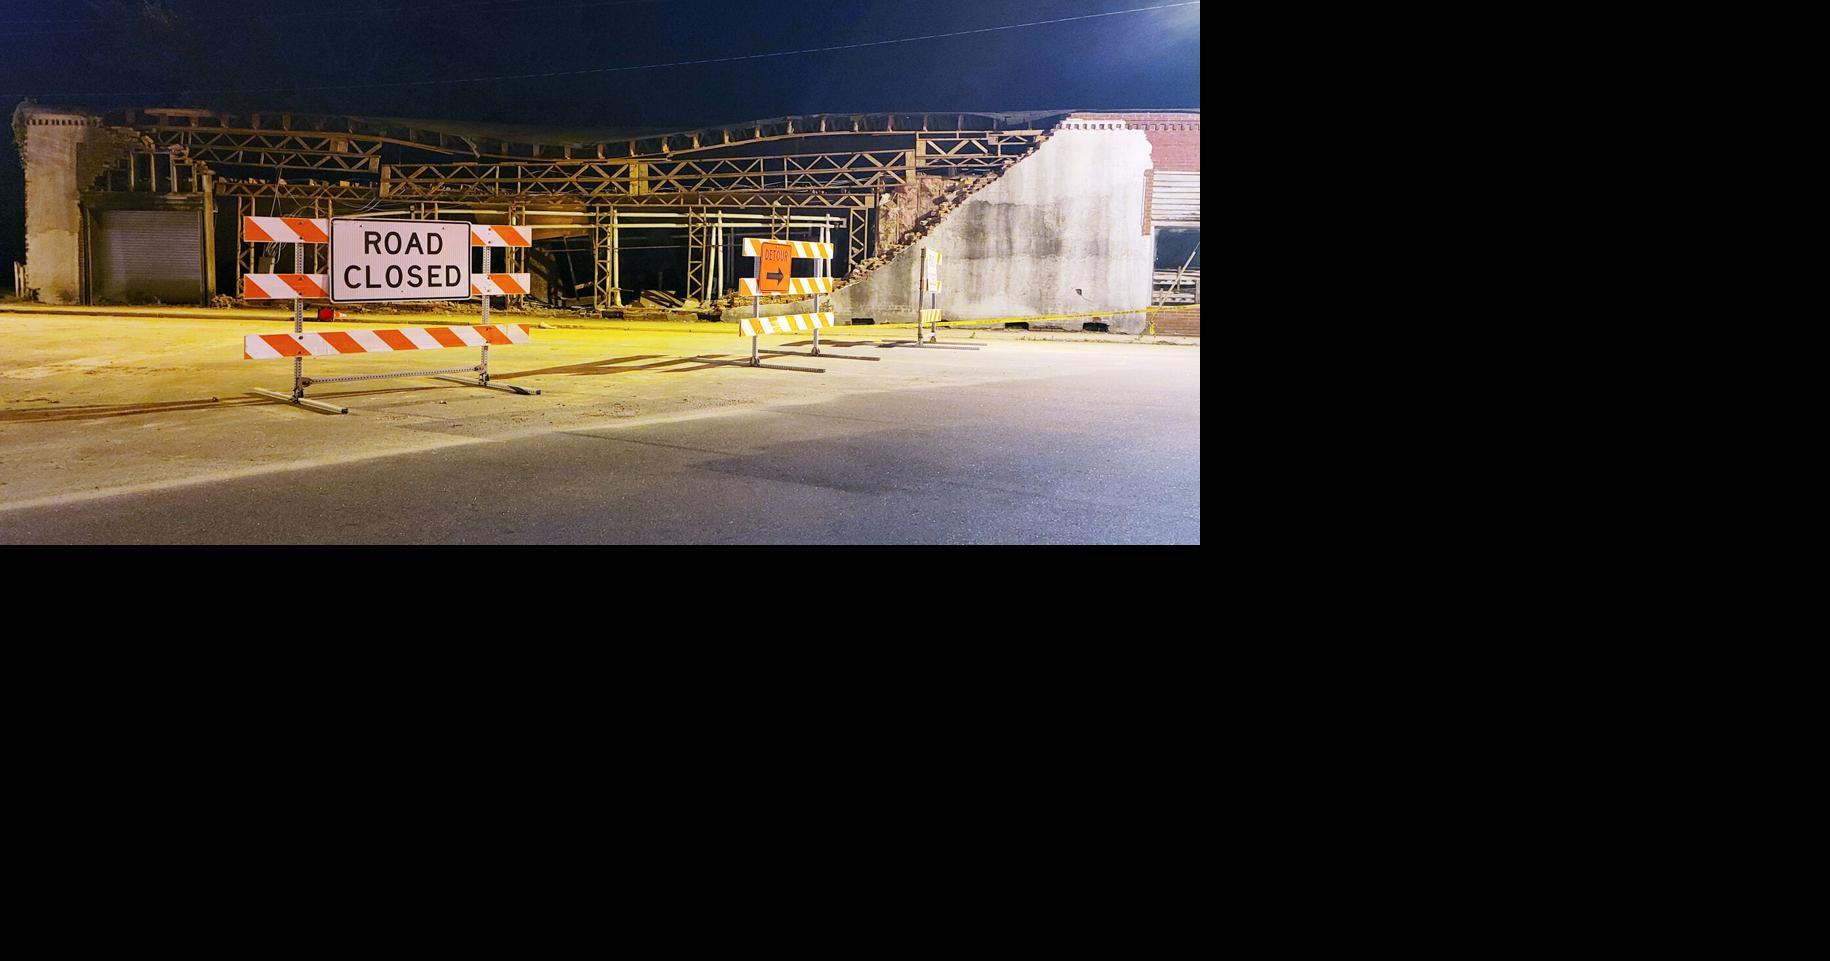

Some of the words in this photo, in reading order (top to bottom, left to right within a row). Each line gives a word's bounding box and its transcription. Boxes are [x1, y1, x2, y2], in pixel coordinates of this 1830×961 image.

[364, 231, 443, 255] ROAD
[765, 249, 789, 262] DETOUR
[343, 264, 462, 289] CLOSED
